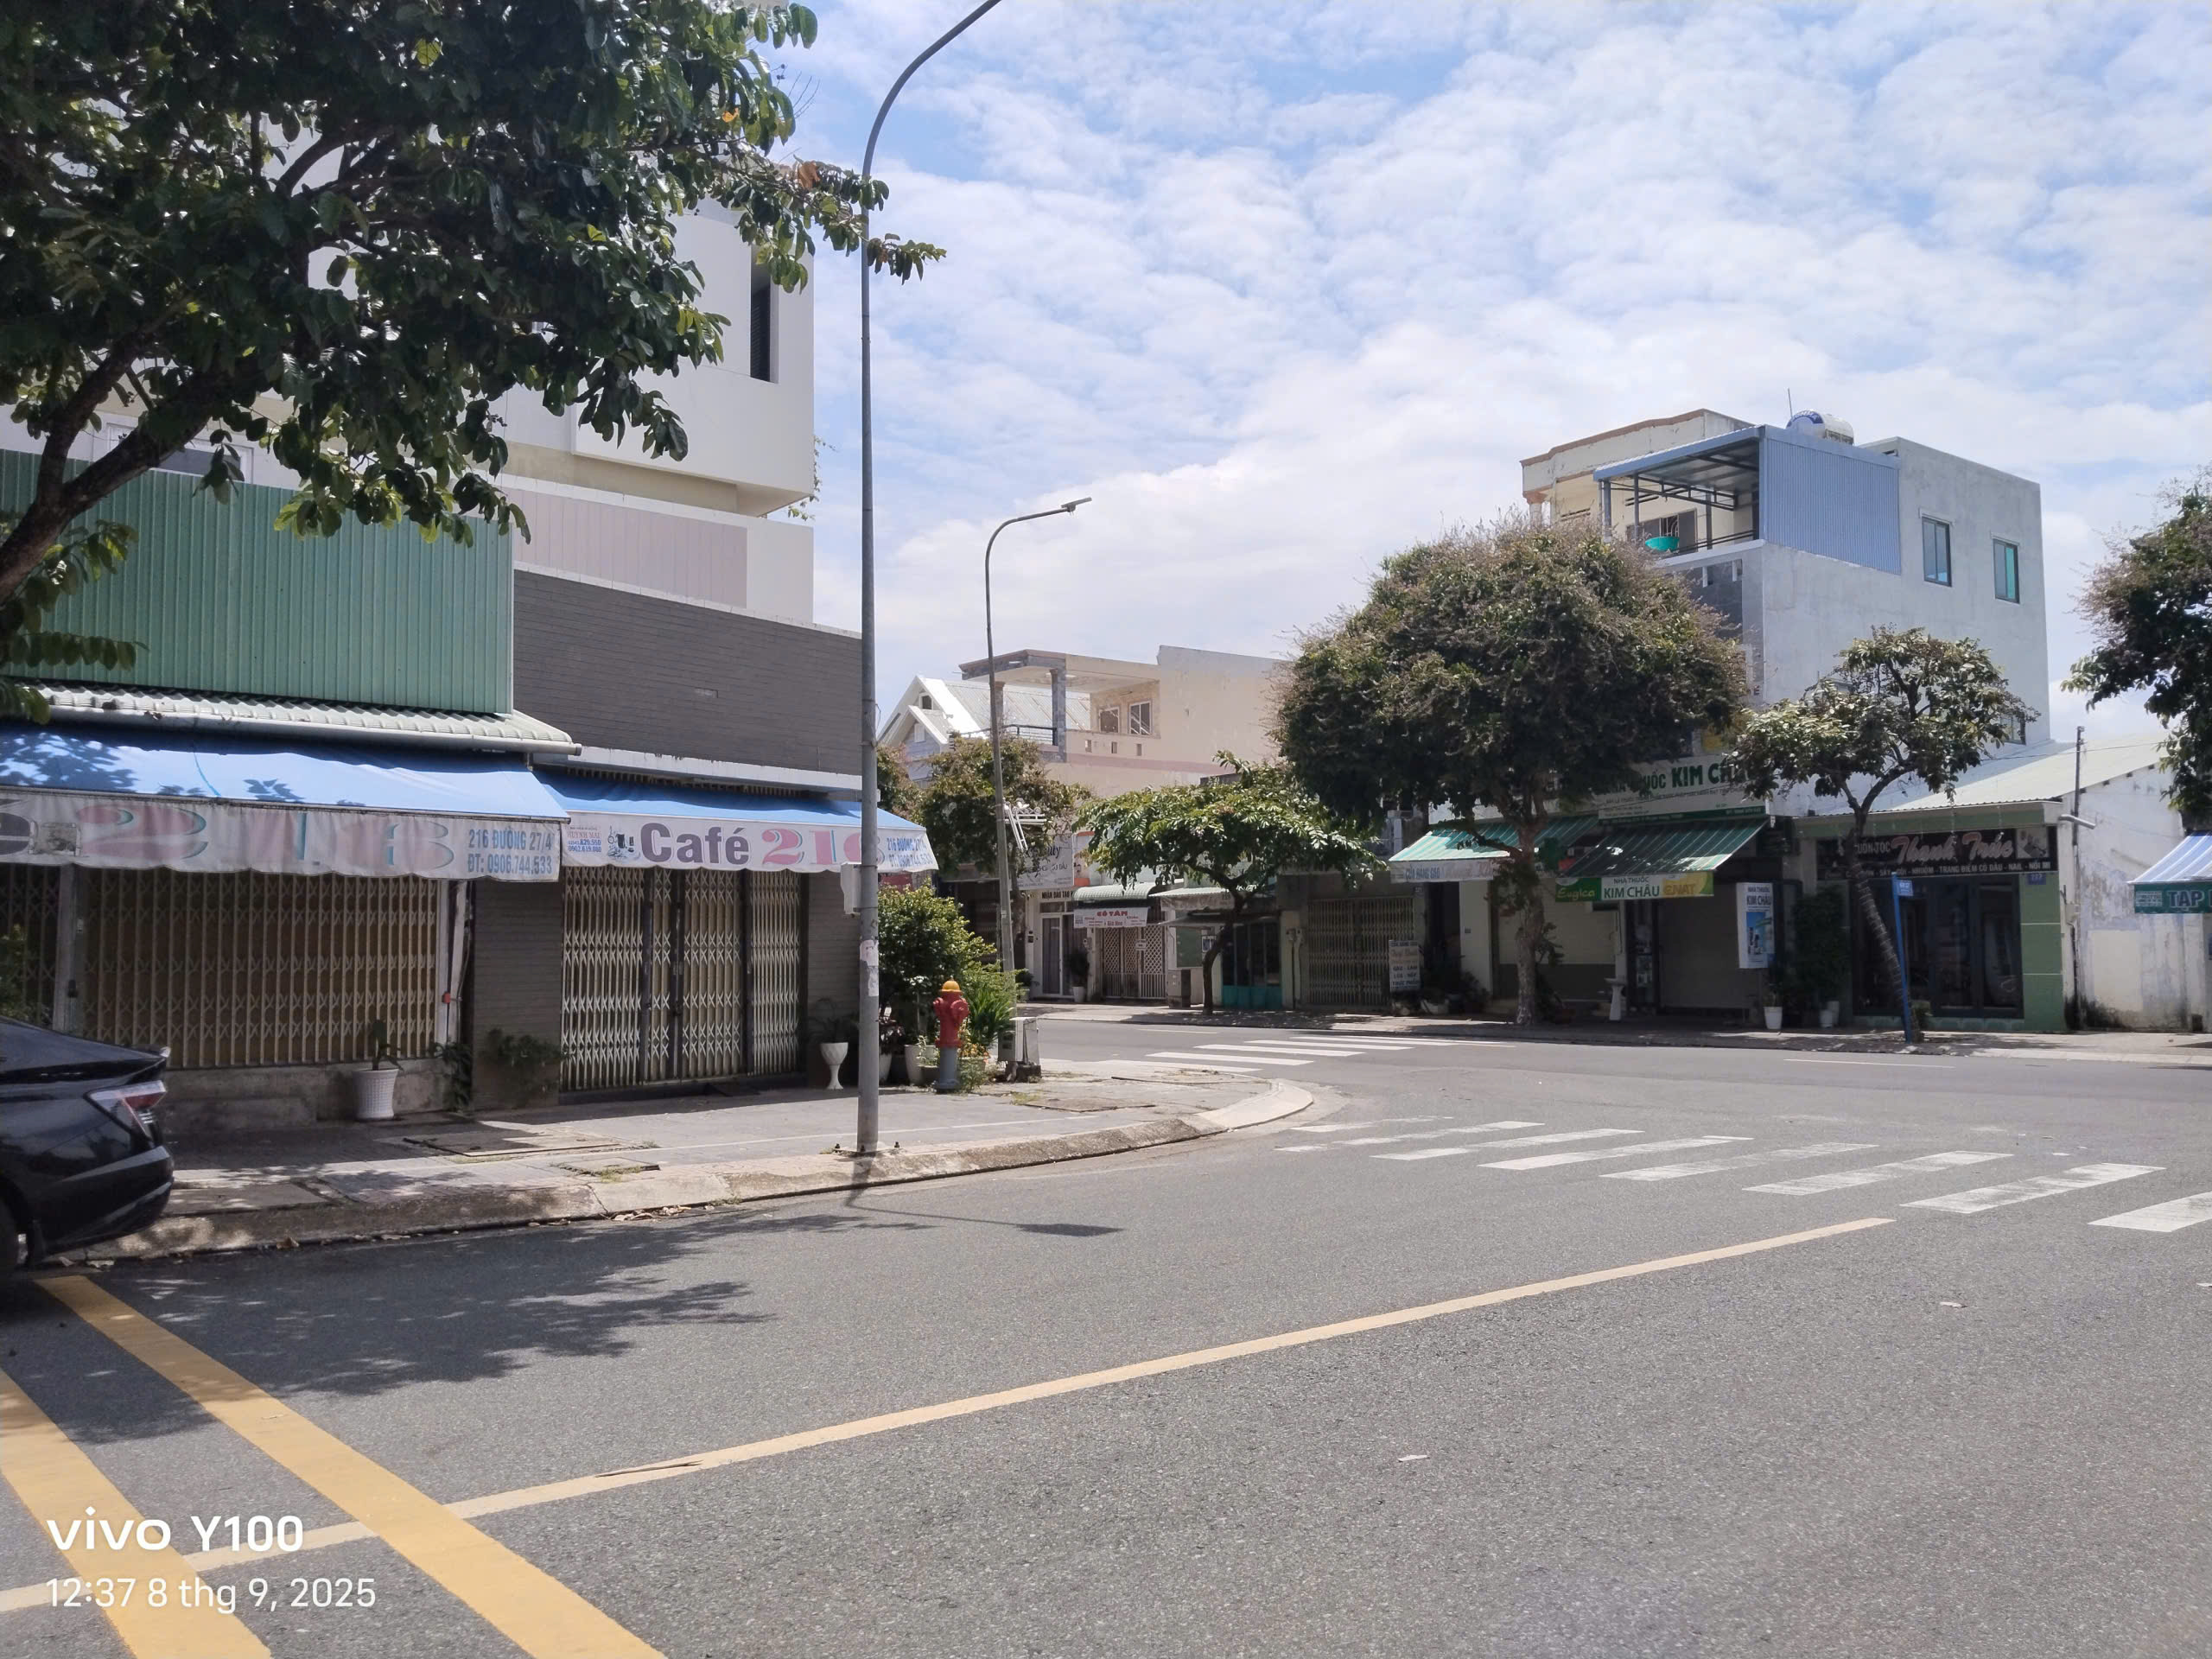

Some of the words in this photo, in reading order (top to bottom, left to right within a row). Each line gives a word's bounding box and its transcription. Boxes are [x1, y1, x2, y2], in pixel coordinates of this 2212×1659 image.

[1672, 765, 1703, 787] KIM
[468, 829, 489, 849] 216
[492, 826, 526, 851] ĐƯỜNG
[529, 831, 552, 851] 27/4
[640, 822, 750, 866] Café
[1891, 832, 1955, 864] Thanh
[467, 854, 485, 873] ĐT:
[487, 854, 552, 874] 0906.744.533
[1939, 865, 1960, 874] TRANG
[1628, 875, 1649, 884] THUỐC
[1557, 887, 1596, 901] Eugica
[1604, 887, 1625, 899] KIM
[1627, 883, 1660, 899] CHÂU
[2166, 890, 2205, 911] TẠP
